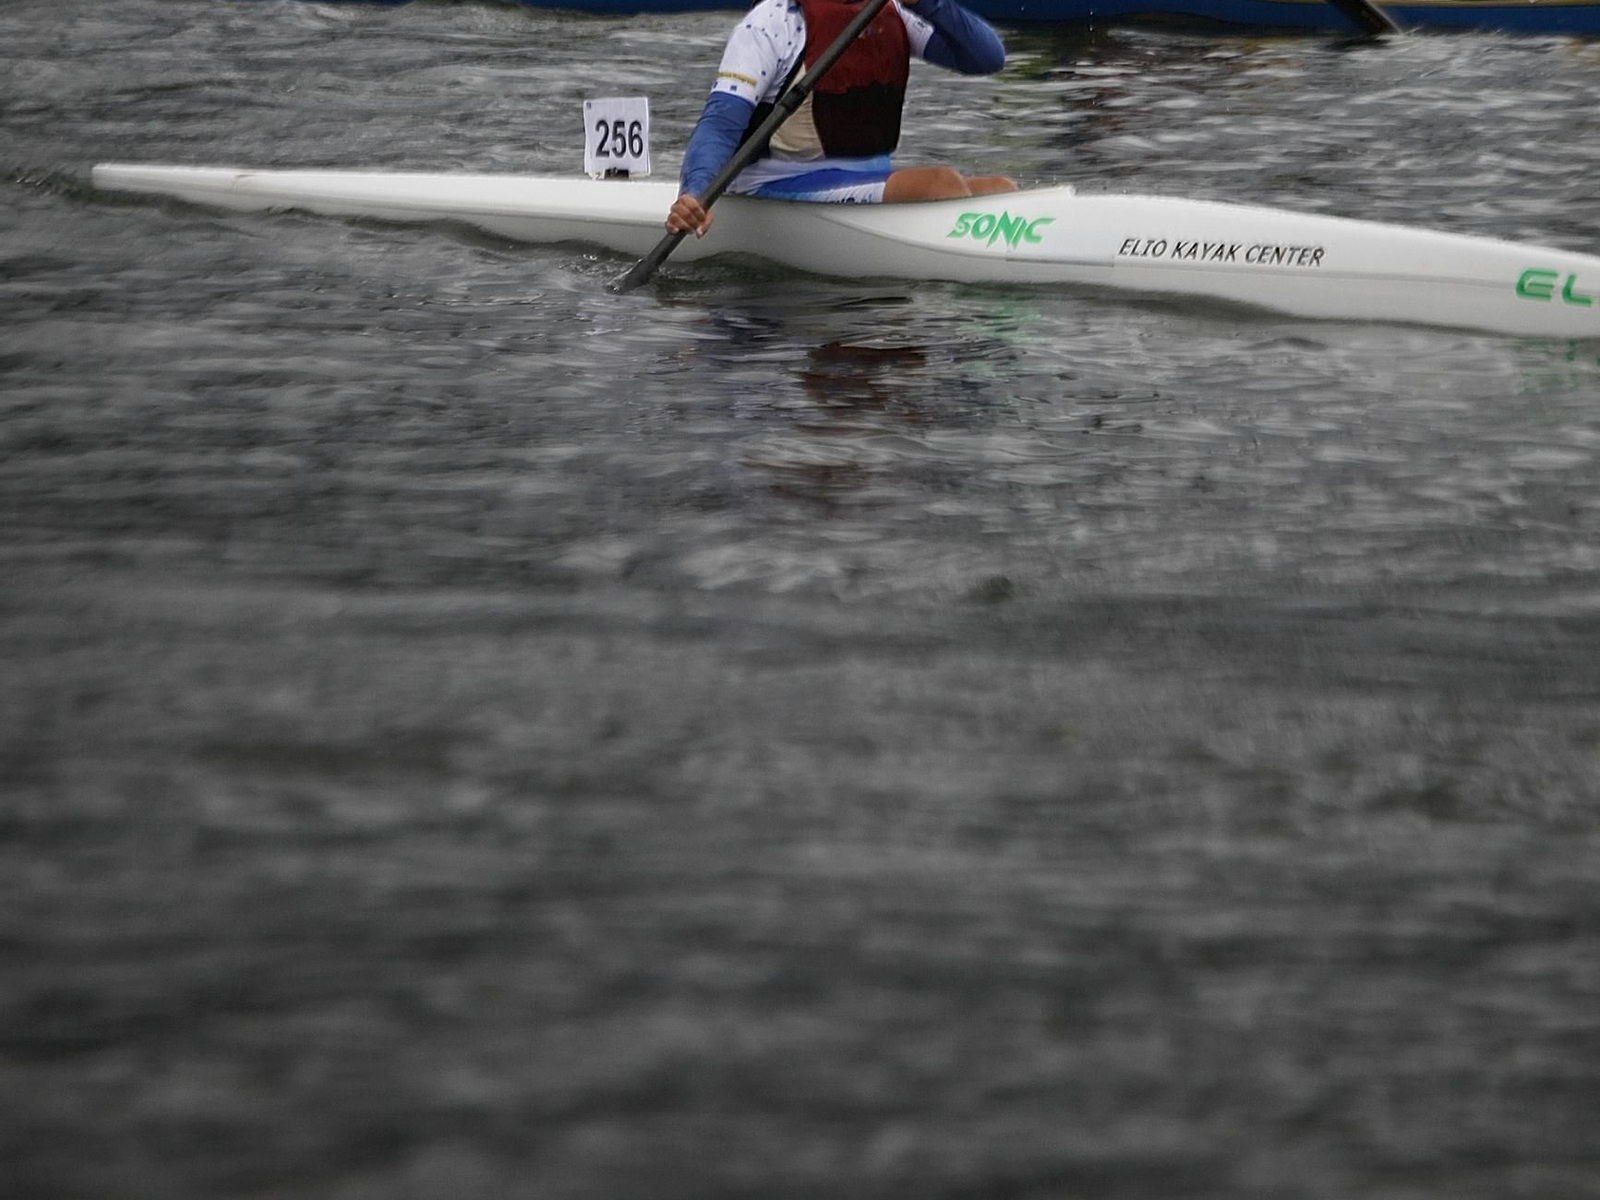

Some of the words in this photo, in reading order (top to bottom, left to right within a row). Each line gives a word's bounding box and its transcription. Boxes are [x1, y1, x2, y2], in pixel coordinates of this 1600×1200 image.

[595, 120, 643, 158] 256
[946, 210, 1056, 249] SONIC
[1118, 238, 1167, 257] ELIO
[1171, 241, 1242, 262] KAYAK
[1245, 245, 1325, 267] CENTER
